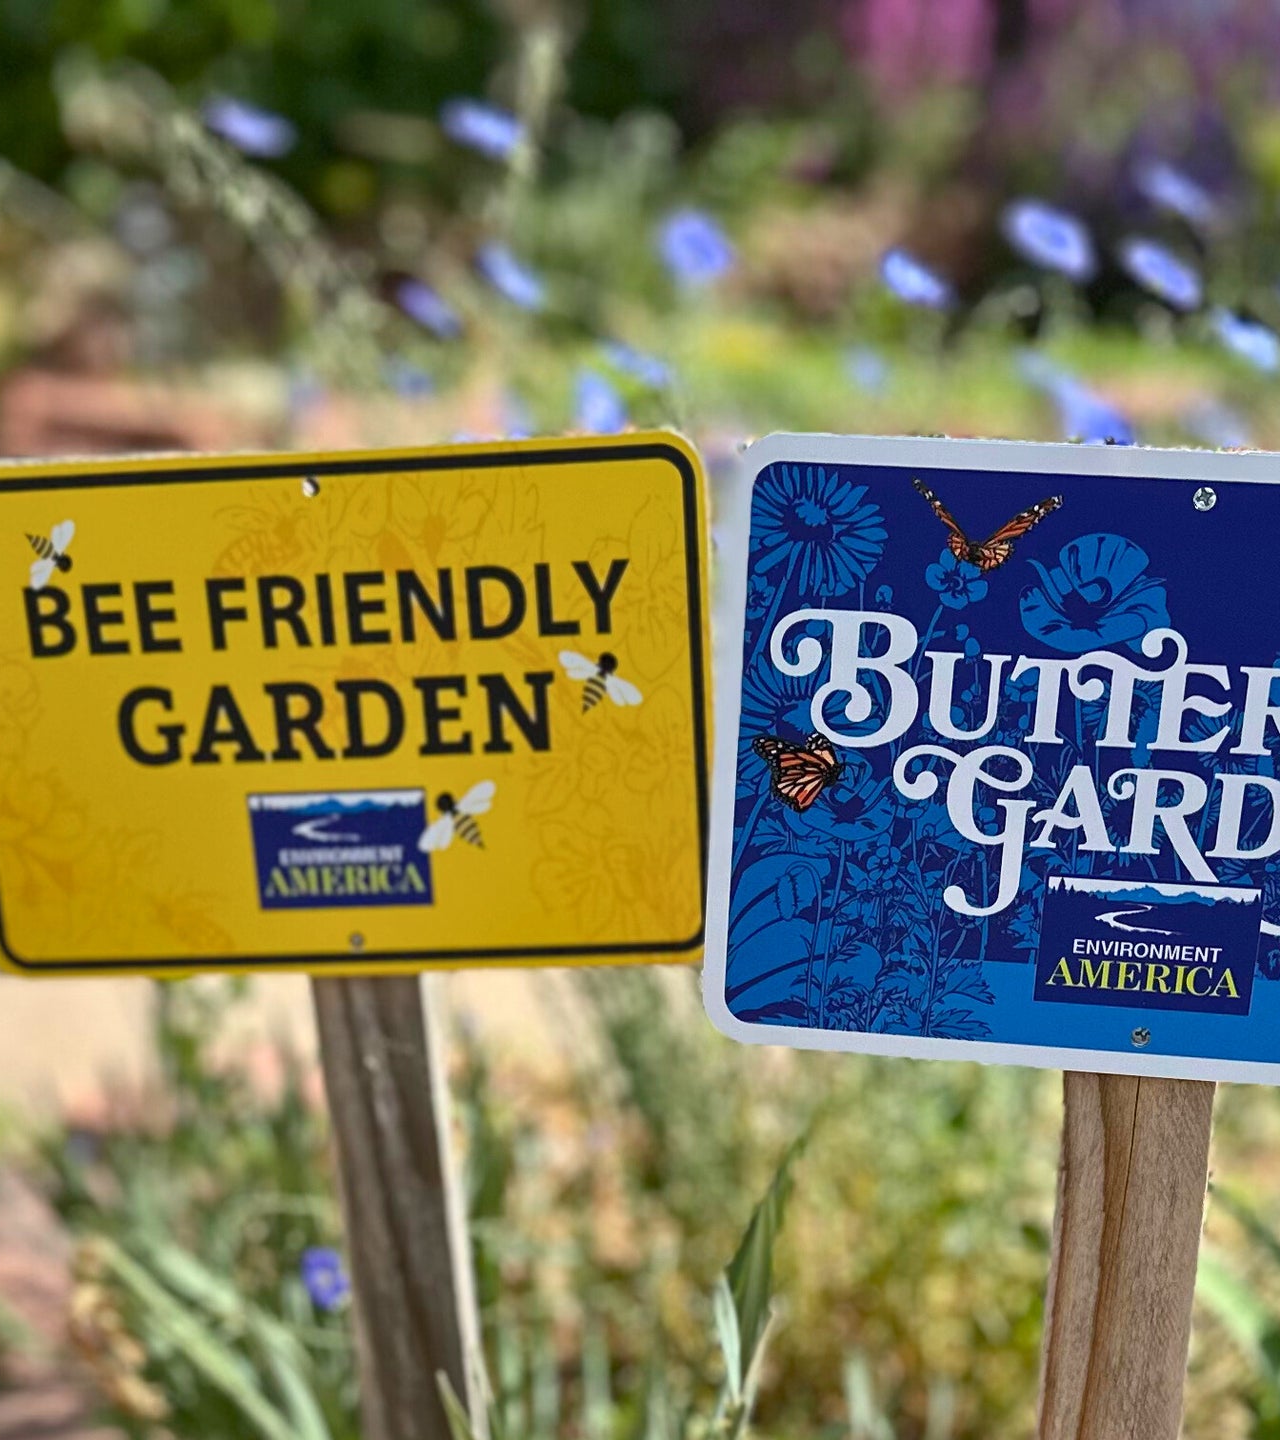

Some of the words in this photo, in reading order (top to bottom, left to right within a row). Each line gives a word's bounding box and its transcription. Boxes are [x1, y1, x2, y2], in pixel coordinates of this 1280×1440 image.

[22, 583, 183, 659] BEE
[205, 558, 630, 651] FRIENDLY
[117, 670, 555, 767] GARDEN
[265, 861, 426, 898] AMERICA
[1072, 938, 1223, 963] ENVIRONMENT
[1045, 956, 1241, 998] AMERICA
